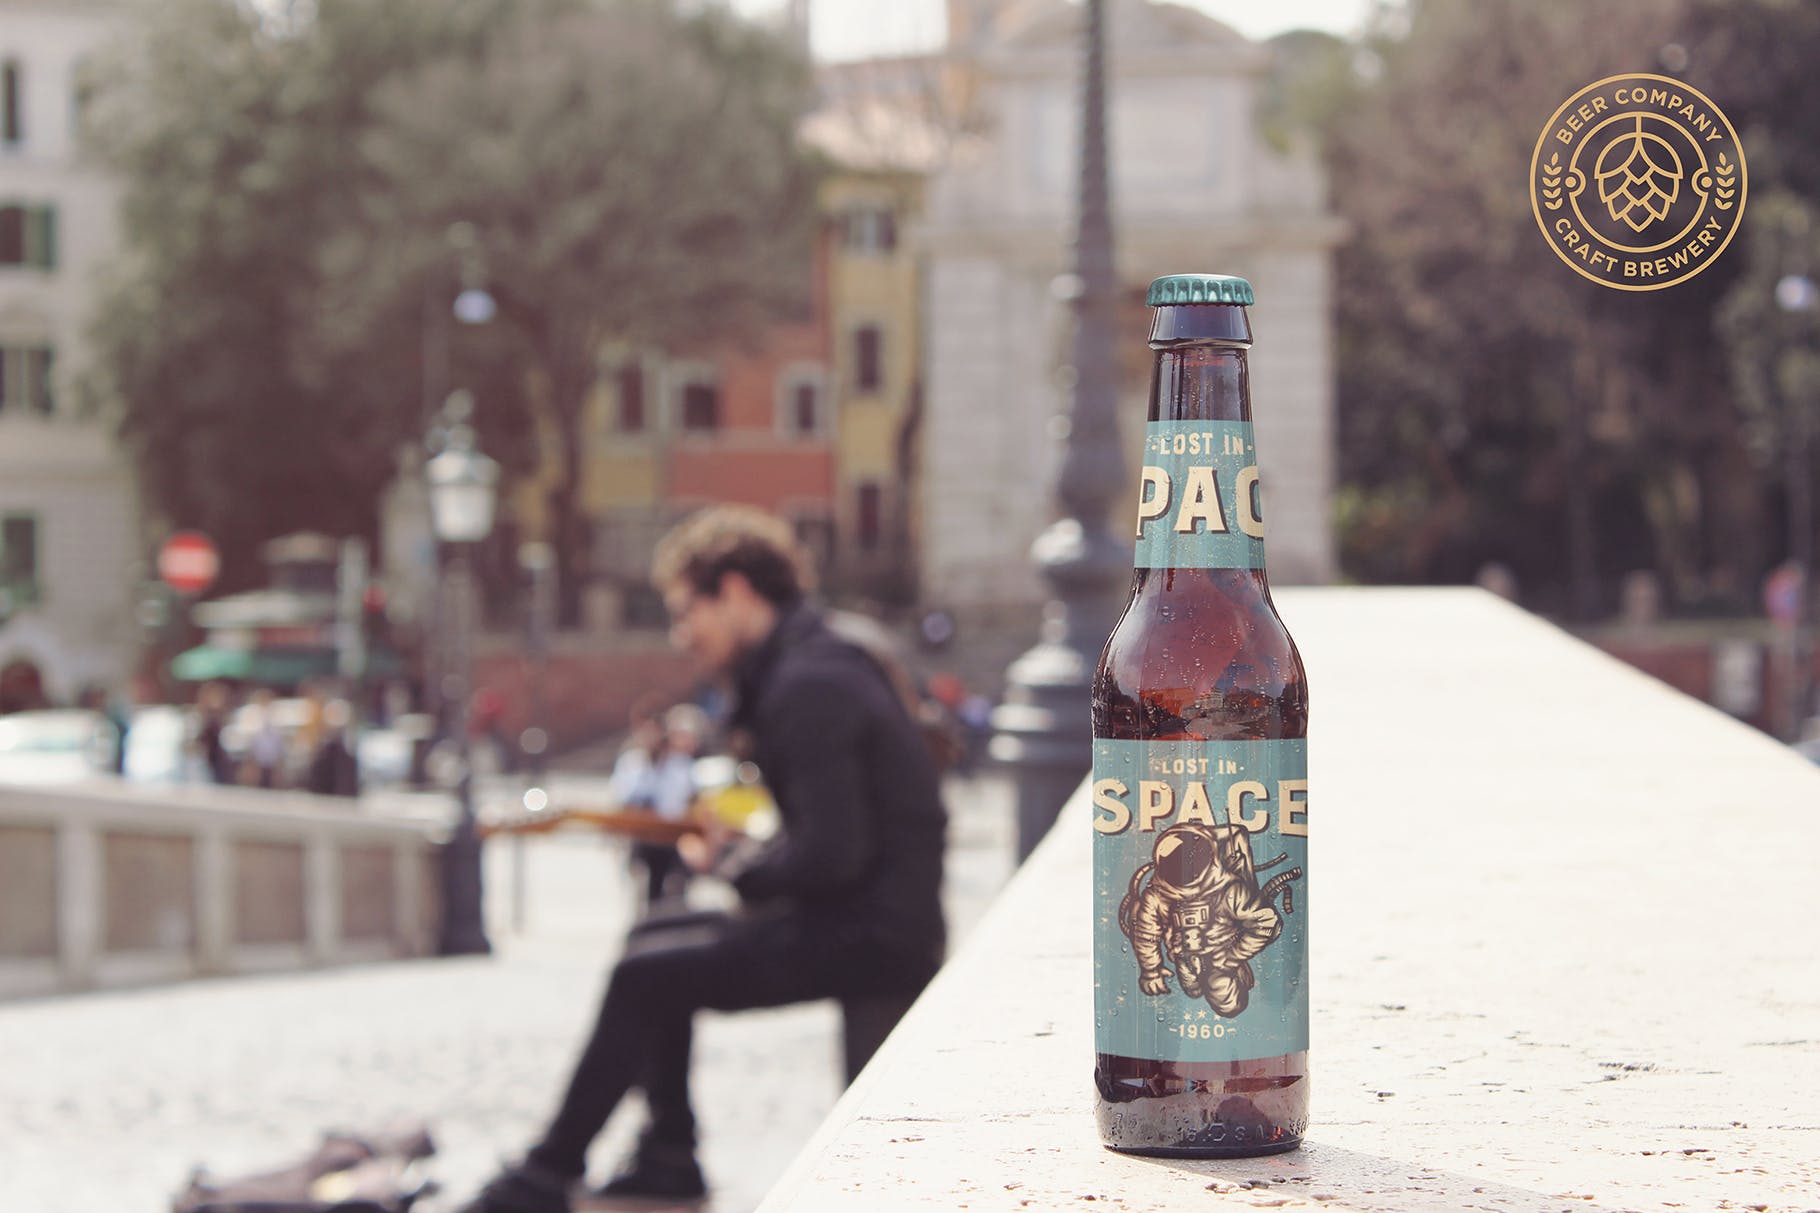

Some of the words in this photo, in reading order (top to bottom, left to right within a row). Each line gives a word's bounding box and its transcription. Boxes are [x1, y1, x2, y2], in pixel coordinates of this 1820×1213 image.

[1159, 432, 1213, 455] LOST
[1223, 434, 1244, 455] IN
[1162, 758, 1209, 775] LOST
[1218, 759, 1237, 775] IN
[1092, 778, 1308, 837] SPACE
